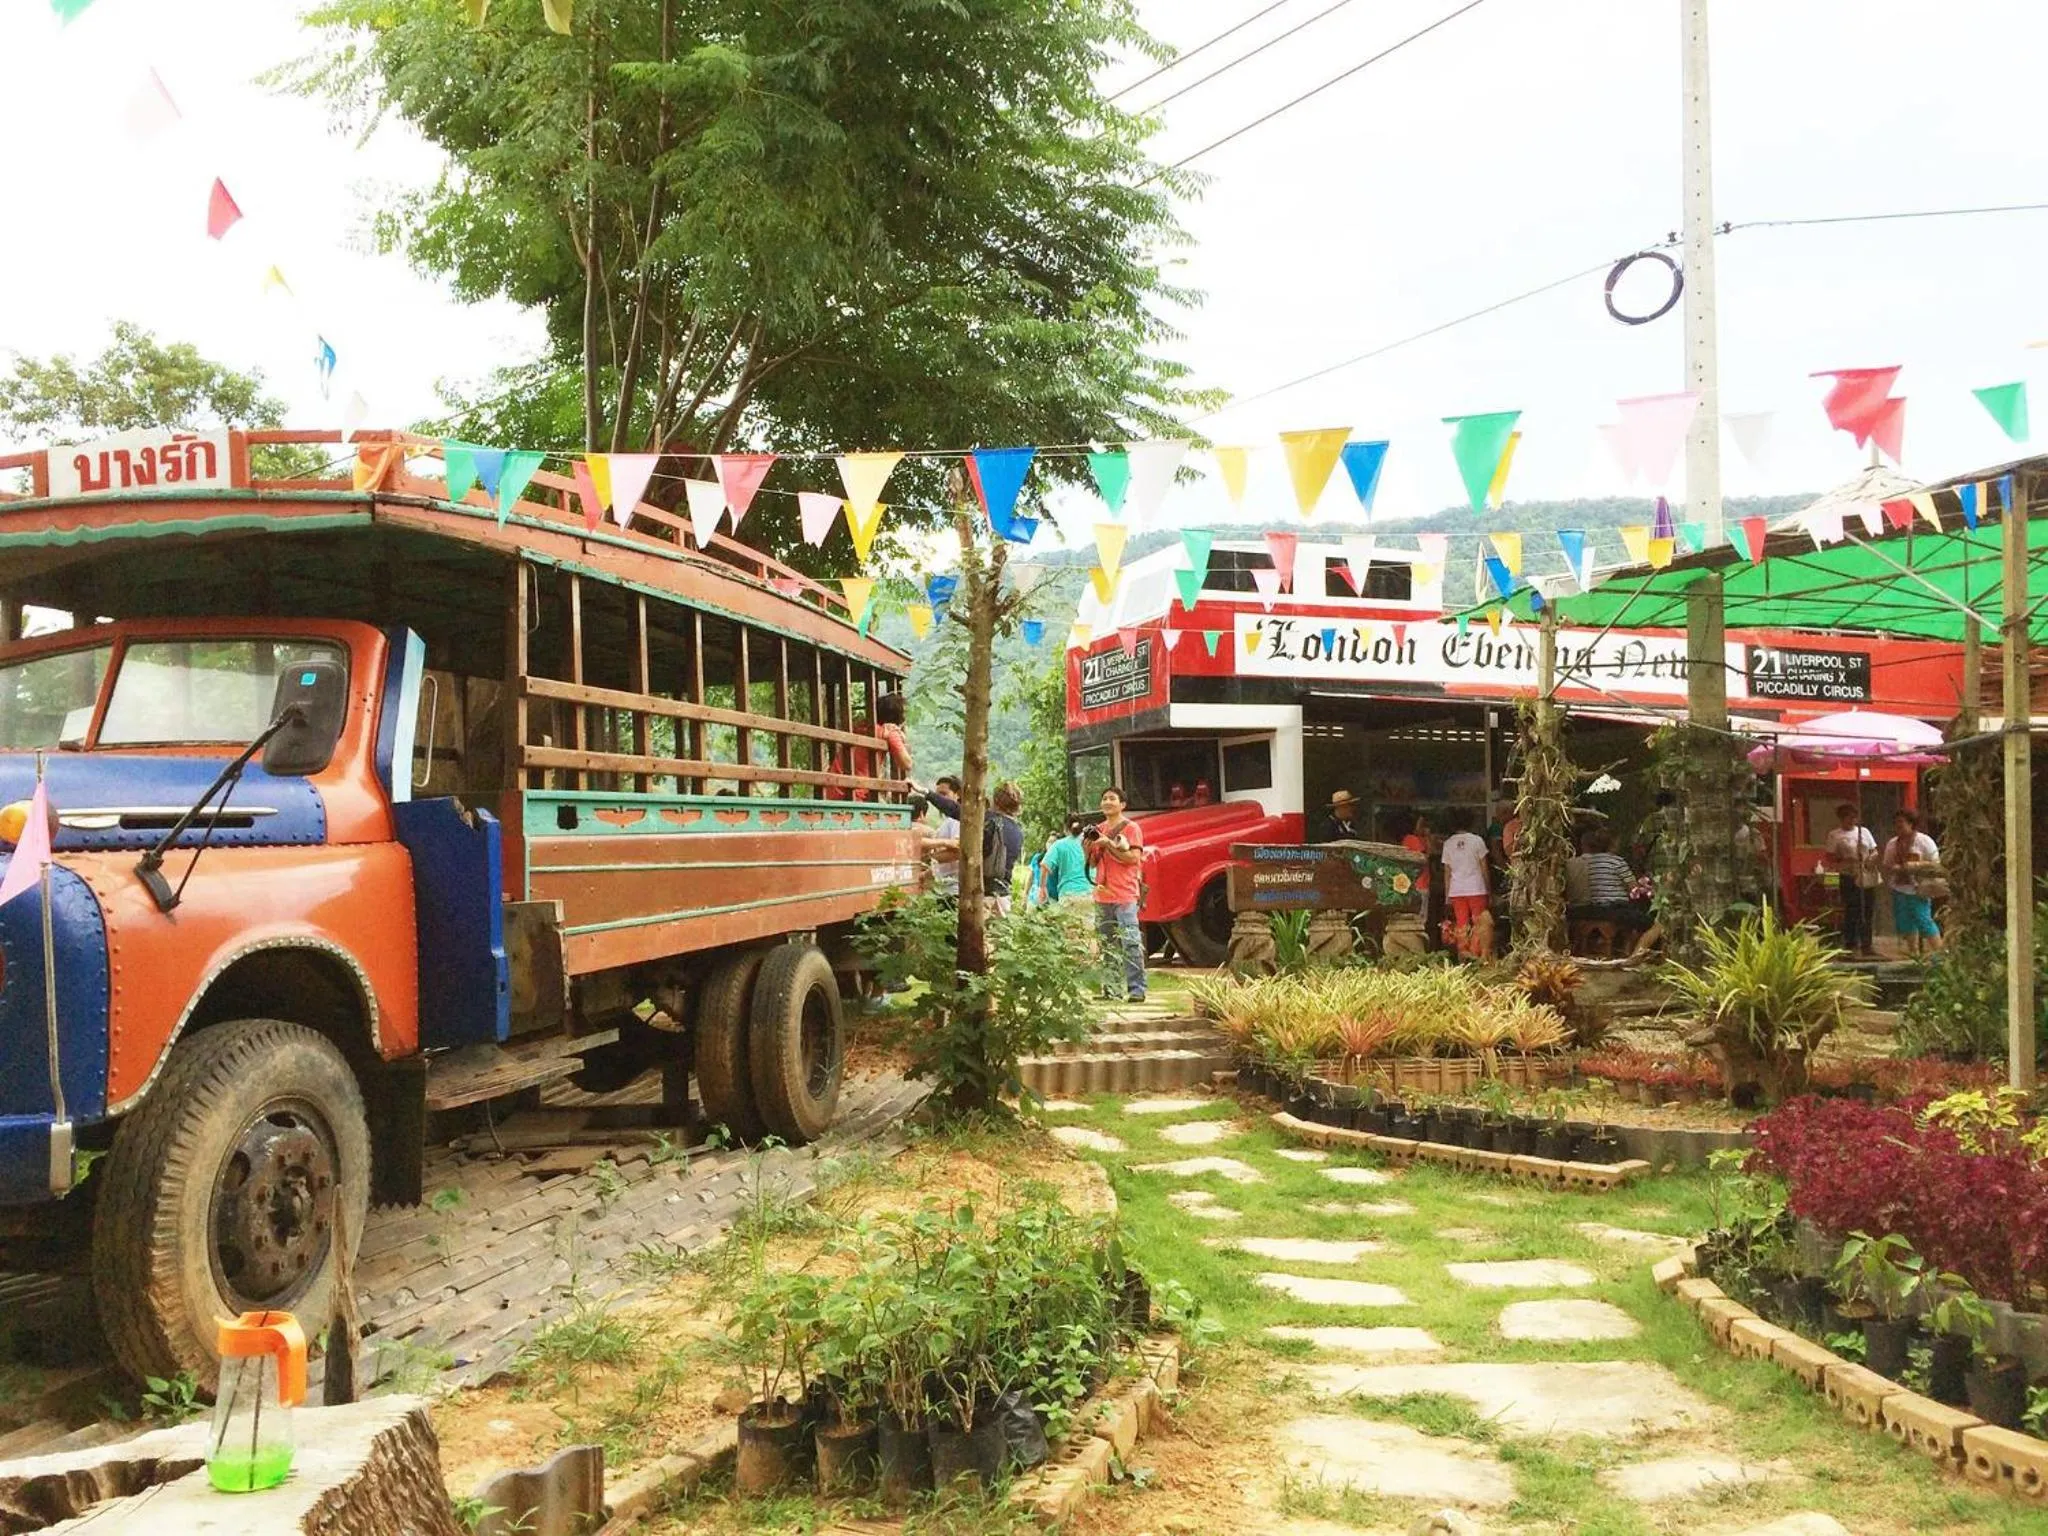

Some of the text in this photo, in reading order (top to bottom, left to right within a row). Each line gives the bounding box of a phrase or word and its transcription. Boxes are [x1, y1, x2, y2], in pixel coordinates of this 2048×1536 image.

[73, 434, 217, 492] บางรัก
[1084, 658, 1101, 686] 21
[1751, 648, 1781, 675] 21
[1785, 653, 1862, 669] LIVERPOOL ST
[1084, 686, 1120, 705] PICCADILLY
[1756, 681, 1865, 698] PICCADILLY CIRCUS
